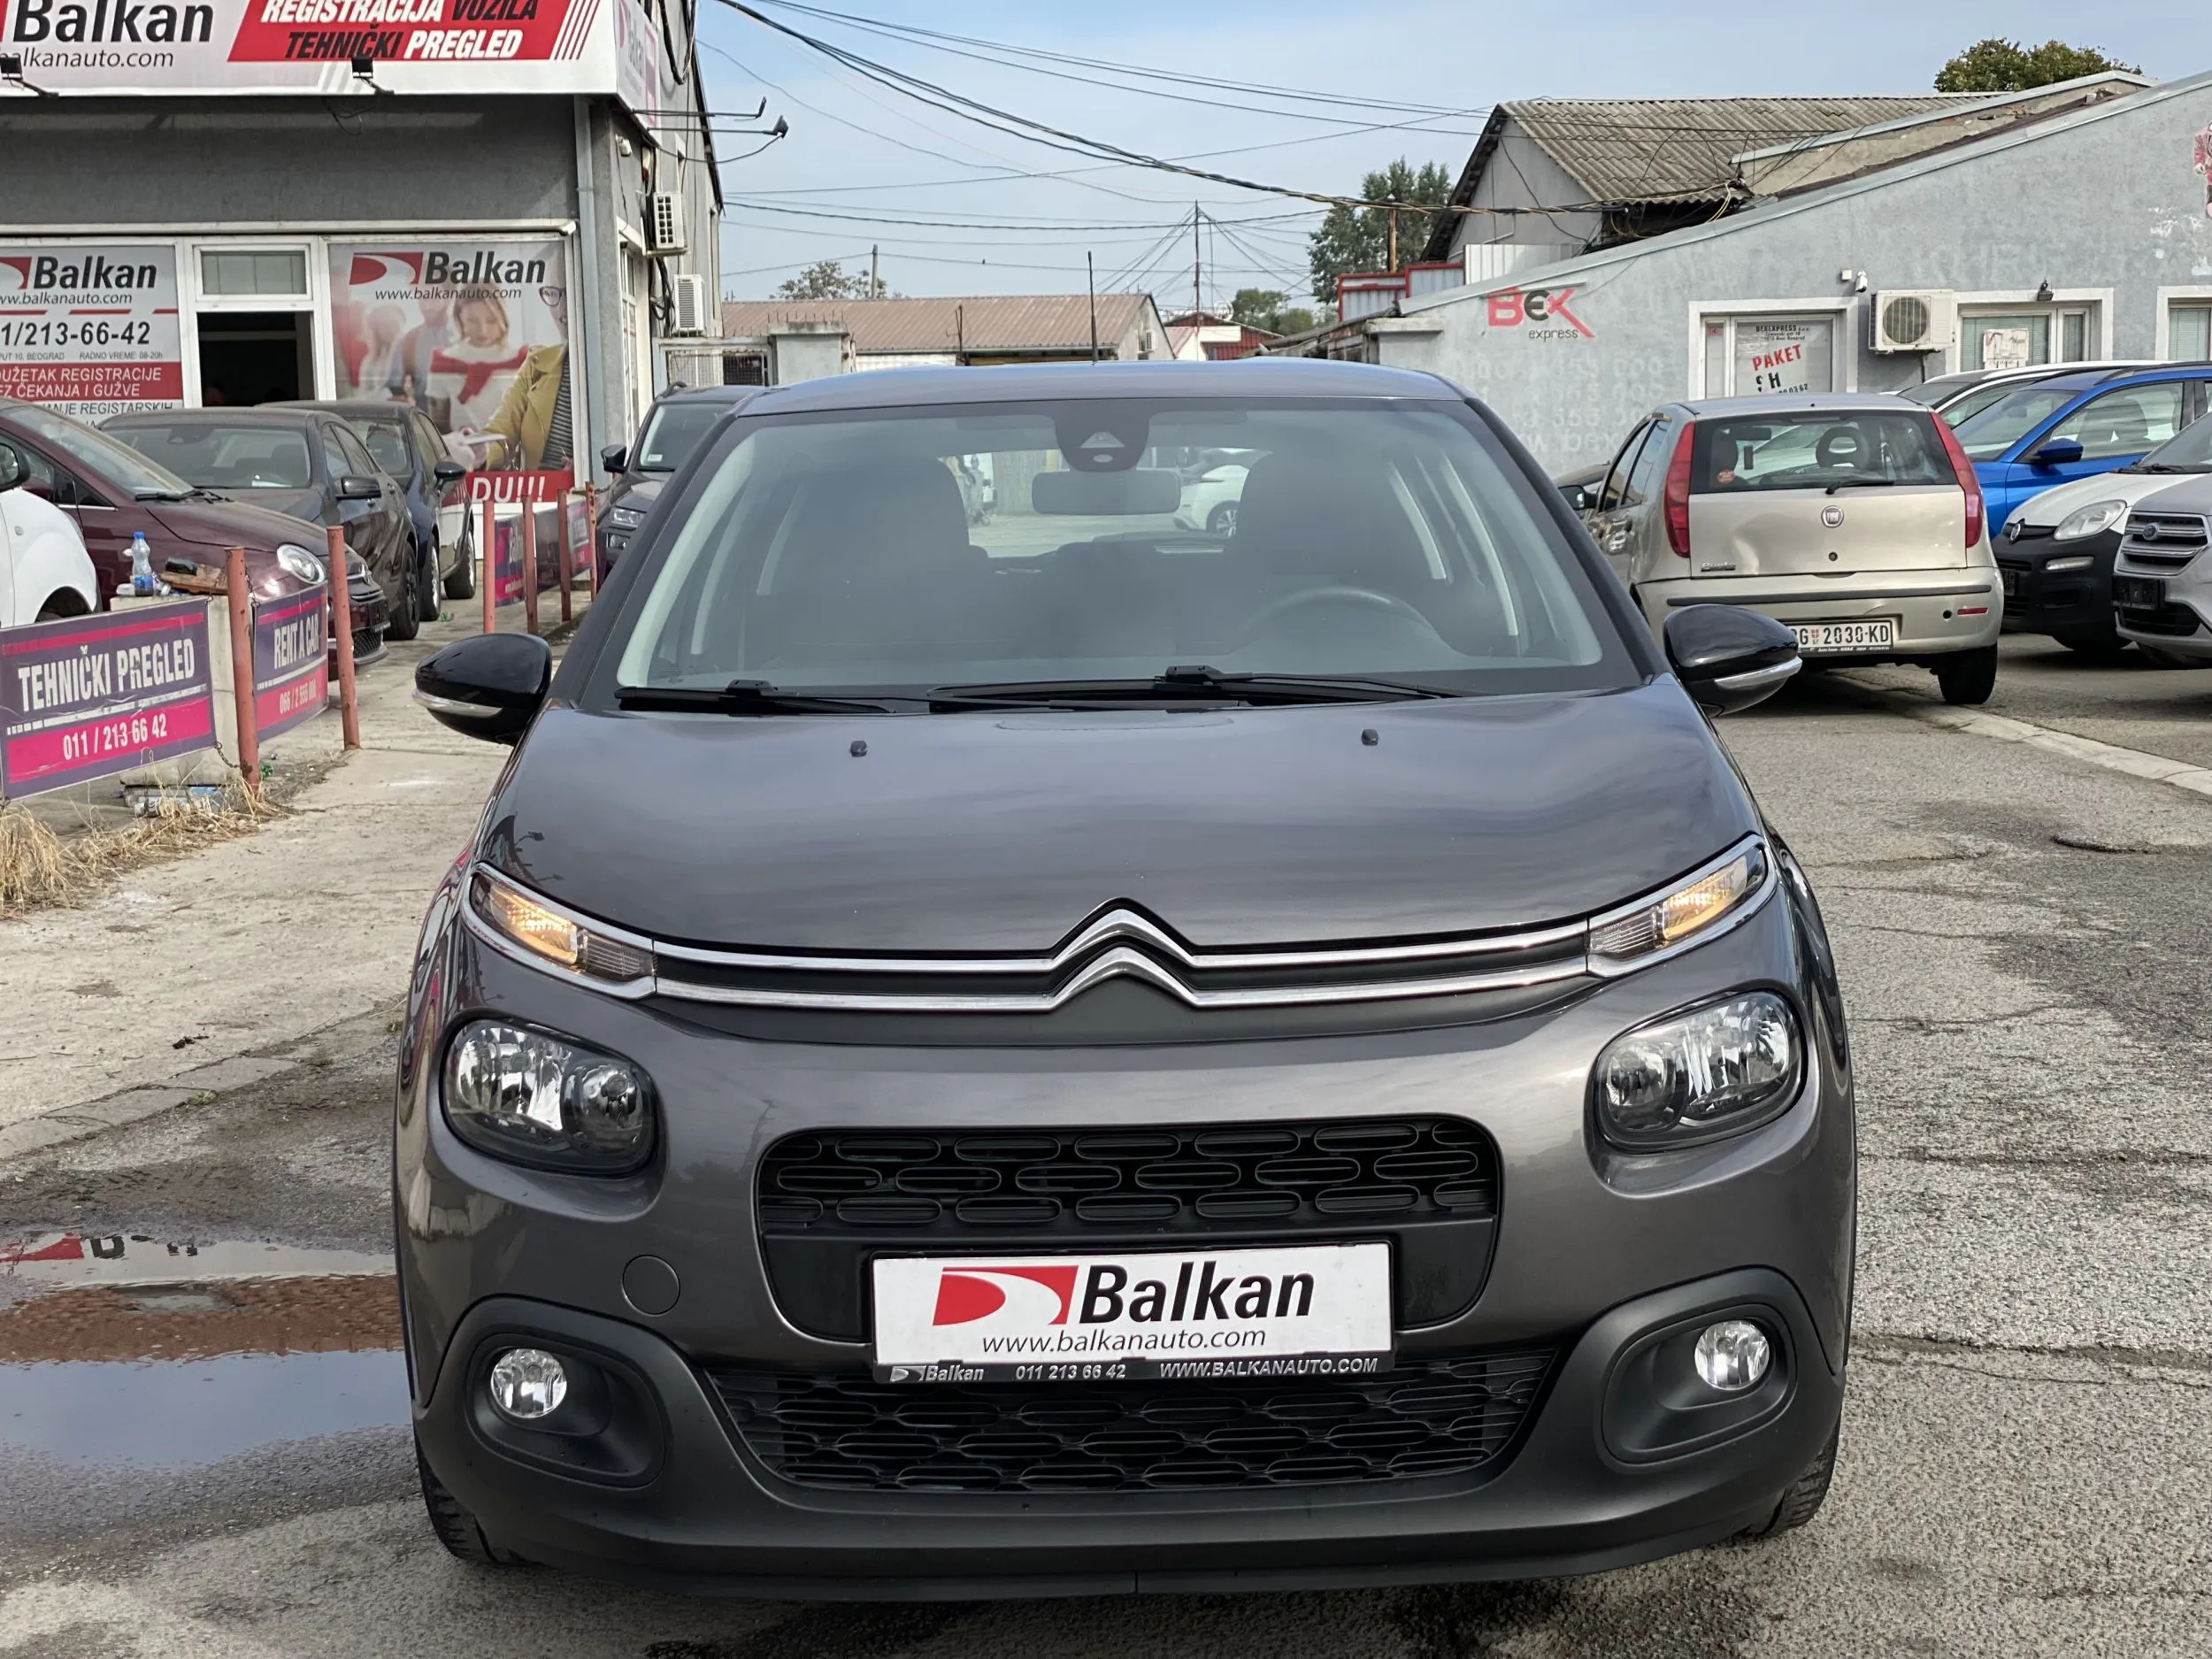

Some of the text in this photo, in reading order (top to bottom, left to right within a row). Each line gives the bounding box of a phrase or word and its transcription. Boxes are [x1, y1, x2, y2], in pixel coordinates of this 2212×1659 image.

[13, 0, 214, 42] Balkan
[260, 0, 537, 23] REGISTRACIJA VOZILA
[285, 23, 523, 59] TEHNIČKI PREGLED
[34, 256, 157, 289] Balkan
[425, 251, 546, 284] Balkan
[375, 286, 522, 301] www.balkanauto.com
[1, 321, 151, 347] 1/213-66-42
[1528, 328, 1579, 342] express
[1752, 344, 1801, 372] PAKET
[0, 365, 162, 382] UŽETAK REGISTRACIJE
[17, 381, 81, 398] ČEKANJA
[85, 385, 88, 396] I
[93, 381, 141, 397] GUŽVE
[273, 612, 319, 670] RENT A CAR
[18, 638, 196, 712] TEHNIČKI PREGLED
[63, 730, 88, 760] 011
[104, 721, 128, 750] 213
[133, 718, 149, 743] 66
[152, 713, 168, 738] 42
[1079, 1260, 1316, 1325] Balkan
[982, 1328, 1266, 1354] www.balkanauto.com
[926, 1358, 1379, 1382] Balkan 011 213 66 42 WWW.BALKANAUTO.COM
